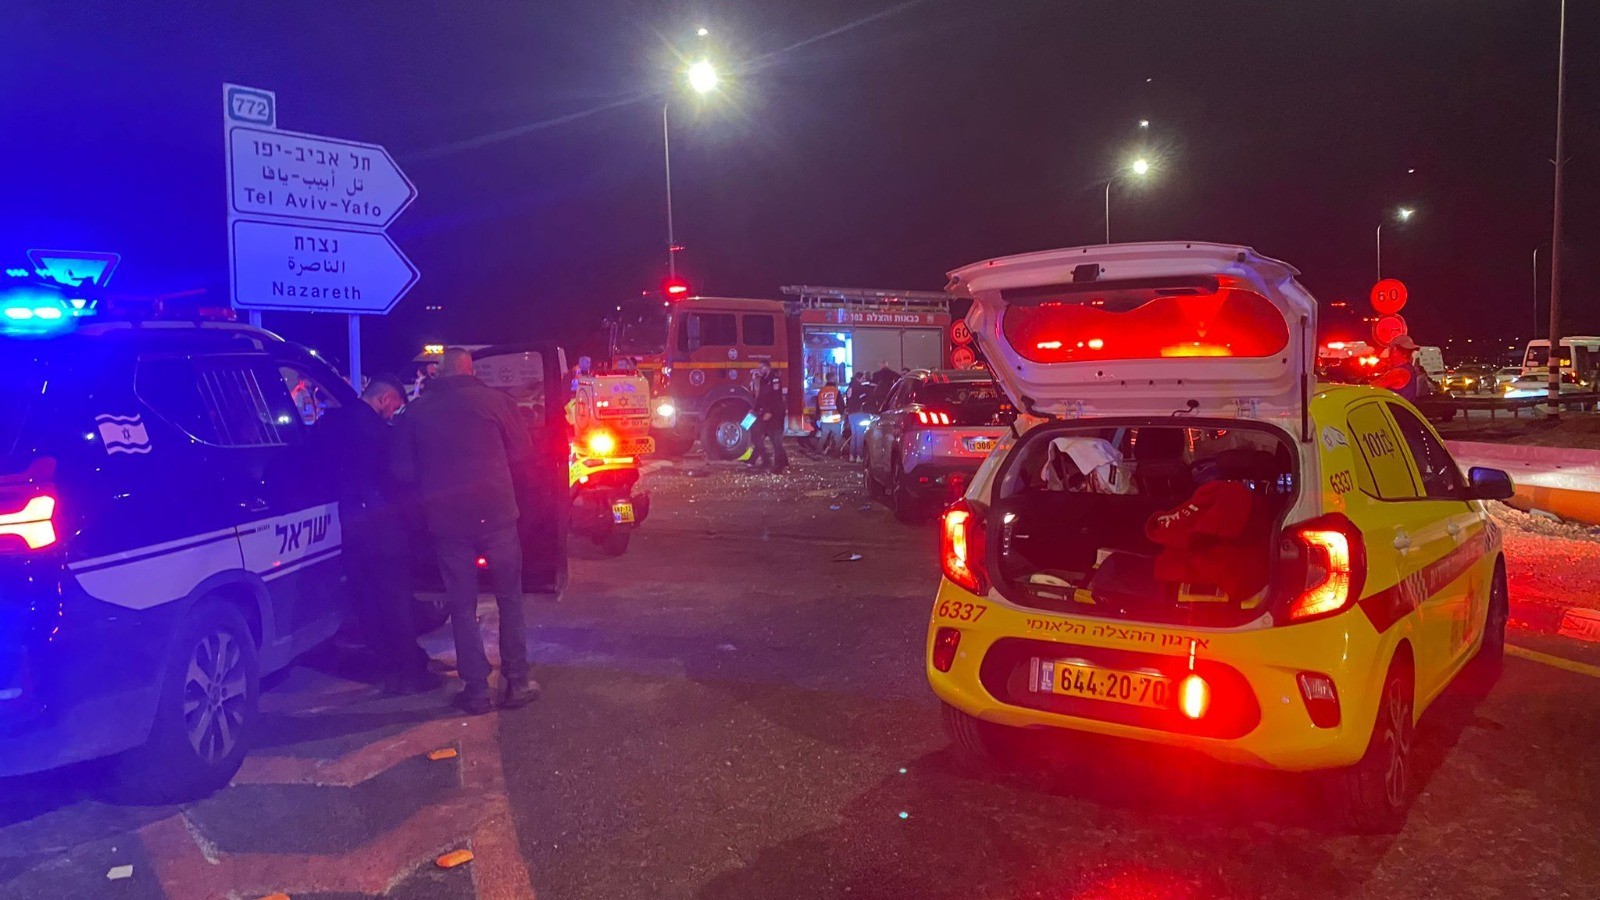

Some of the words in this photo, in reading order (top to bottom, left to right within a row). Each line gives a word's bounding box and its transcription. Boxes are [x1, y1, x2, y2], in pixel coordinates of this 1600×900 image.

[235, 97, 267, 117] 772
[253, 140, 339, 167] אביב-יפו
[350, 152, 371, 172] תל
[346, 177, 363, 196] تل
[243, 187, 273, 206] Tel
[285, 192, 382, 217] Aviv-Yafo
[294, 235, 338, 253] נצרת
[288, 256, 345, 276] الناصرة
[272, 281, 361, 300] Nazareth
[1378, 289, 1398, 301] 60
[850, 313, 863, 322] 102
[866, 313, 892, 323] והצלה
[894, 314, 919, 323] כבאות
[954, 326, 969, 338] 60
[1330, 470, 1354, 495] 6337
[275, 514, 331, 555] ישראל
[938, 600, 987, 622] 6337
[1026, 618, 1086, 635] הלאומי
[1092, 625, 1155, 643] ההצלה
[1161, 633, 1210, 650] ארגון
